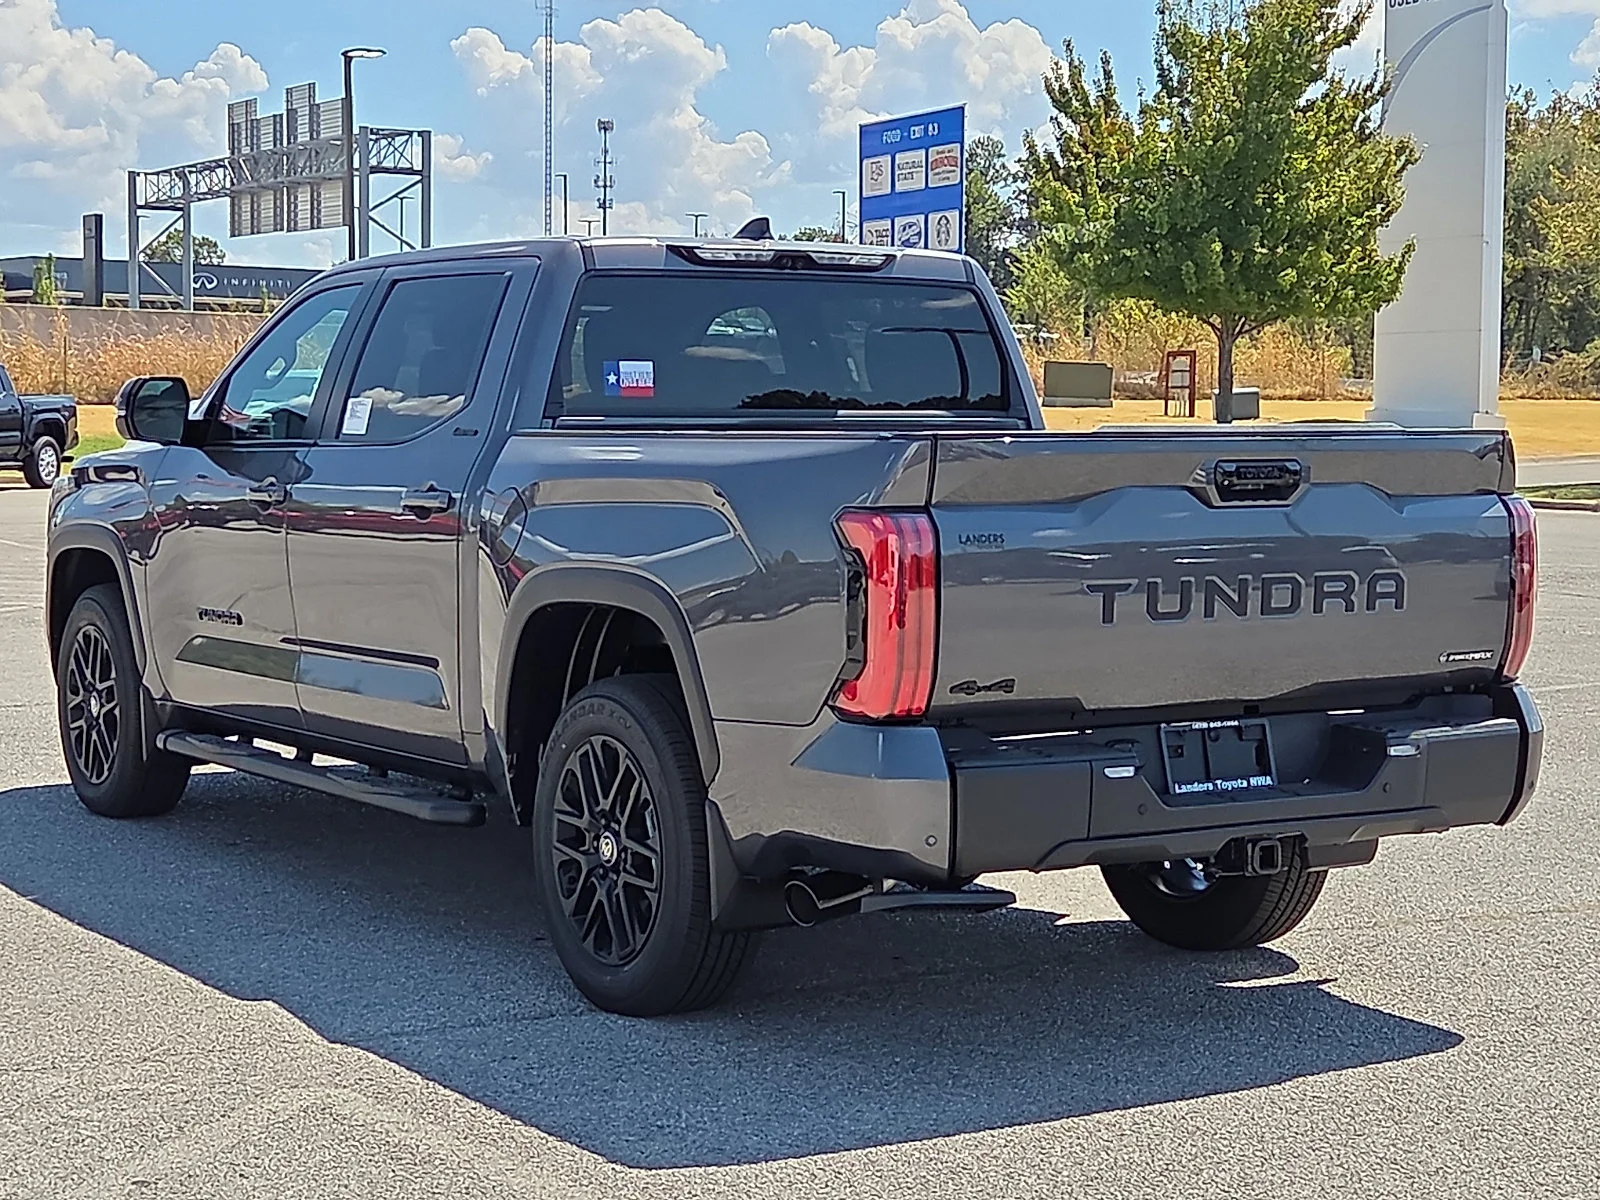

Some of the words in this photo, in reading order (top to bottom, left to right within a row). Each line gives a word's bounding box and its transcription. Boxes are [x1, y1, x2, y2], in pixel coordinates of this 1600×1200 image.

[910, 124, 925, 140] EXIT
[896, 159, 924, 171] NATURAL
[896, 171, 915, 182] STATE
[223, 277, 291, 289] INFINITI
[1239, 466, 1281, 479] TOYOTA
[958, 533, 1005, 545] LANDERS
[1081, 568, 1407, 626] TUNDRA
[196, 606, 244, 626] TUNDRA
[1174, 782, 1214, 794] Landers
[1215, 778, 1248, 791] Toyota
[1249, 775, 1274, 787] NWA
